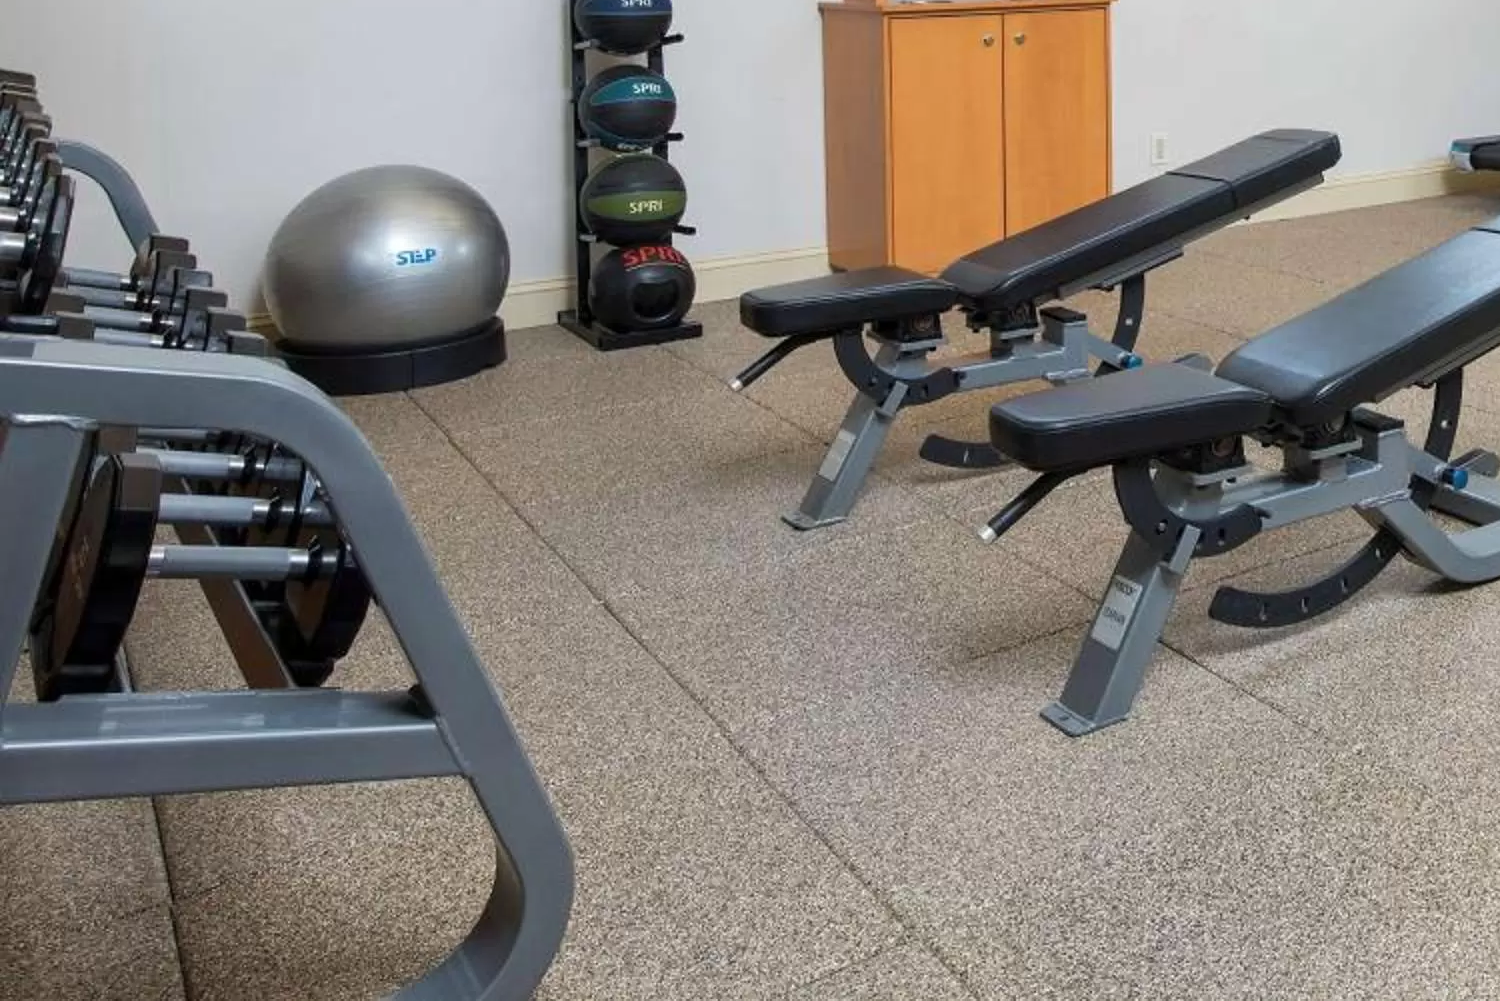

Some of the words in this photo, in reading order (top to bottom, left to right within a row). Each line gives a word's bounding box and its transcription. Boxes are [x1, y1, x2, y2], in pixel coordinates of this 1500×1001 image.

[632, 82, 661, 94] SPRI
[628, 199, 663, 214] SPRI
[396, 248, 436, 266] STEP
